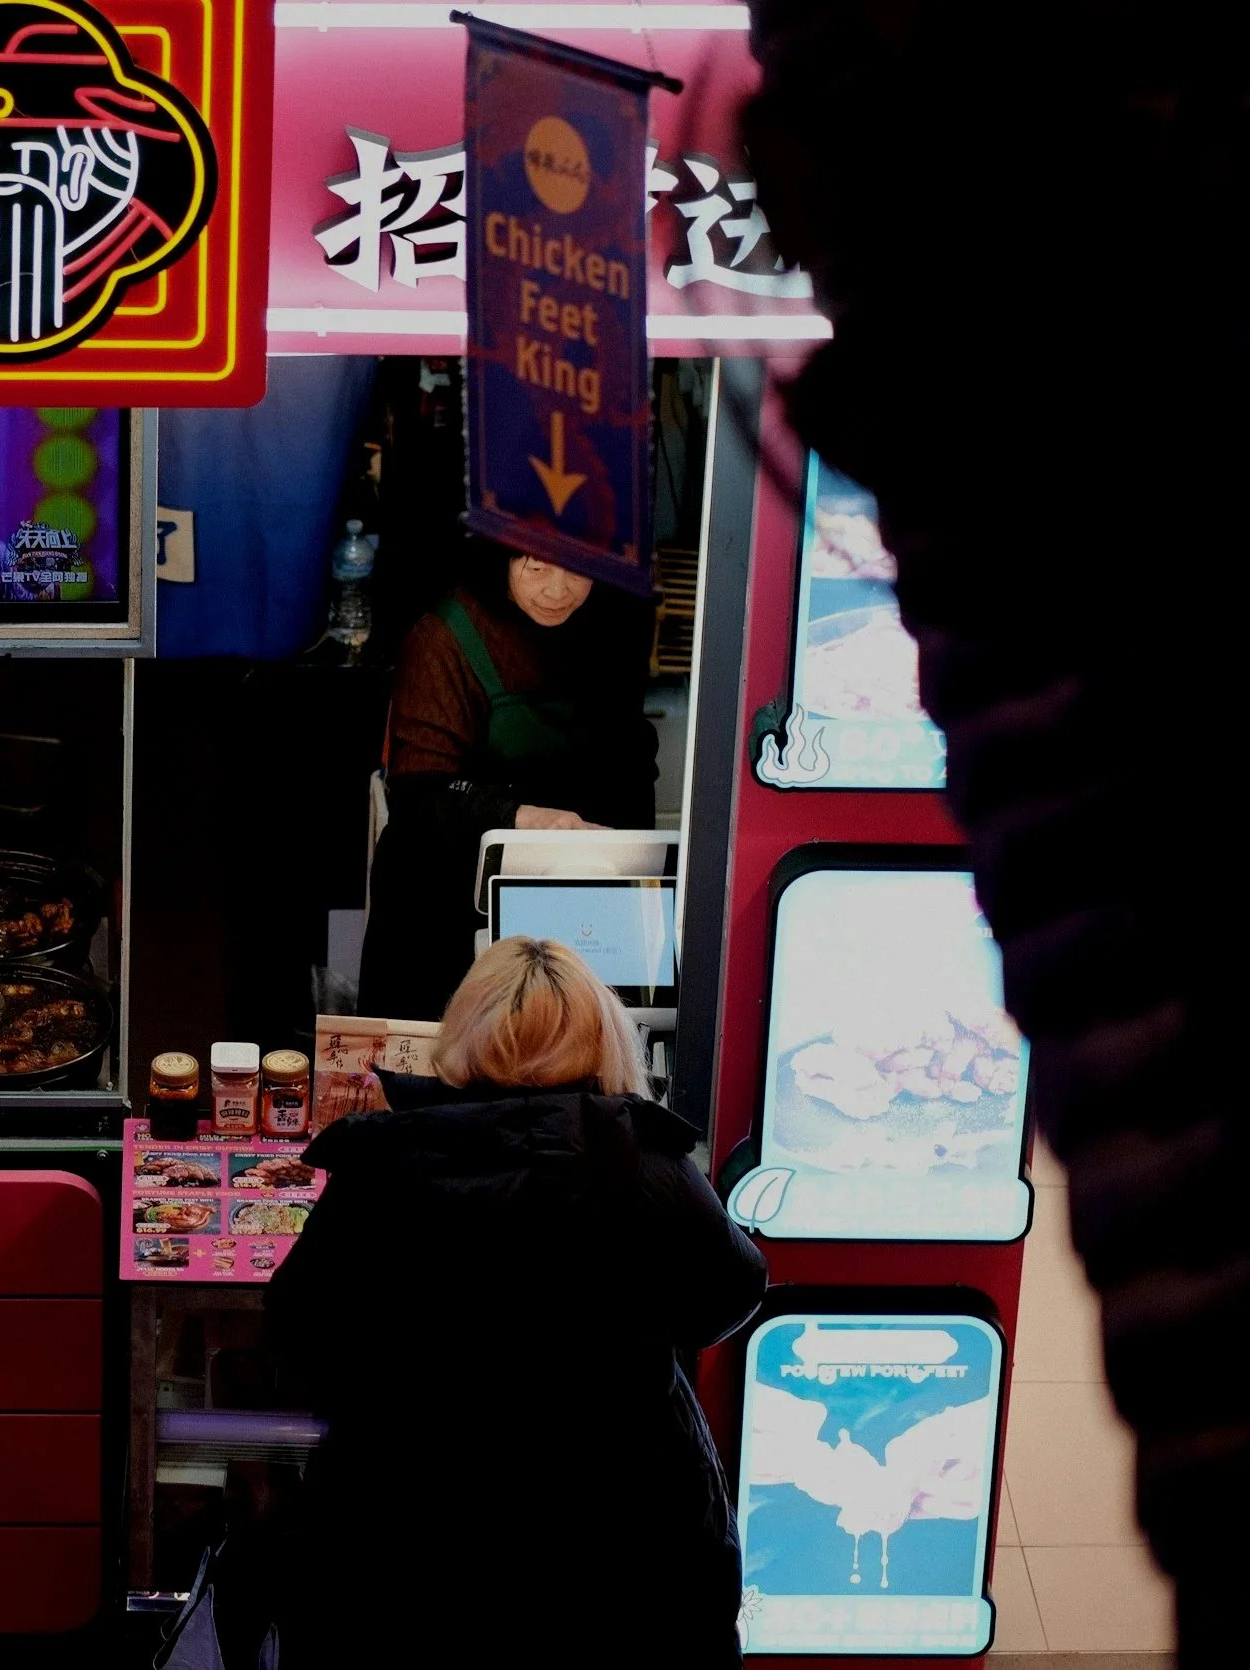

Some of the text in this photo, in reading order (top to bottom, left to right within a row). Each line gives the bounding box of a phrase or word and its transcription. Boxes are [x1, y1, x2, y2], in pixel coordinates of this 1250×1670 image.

[485, 209, 631, 301] Chicken
[518, 280, 600, 347] Feet
[516, 337, 602, 413] King
